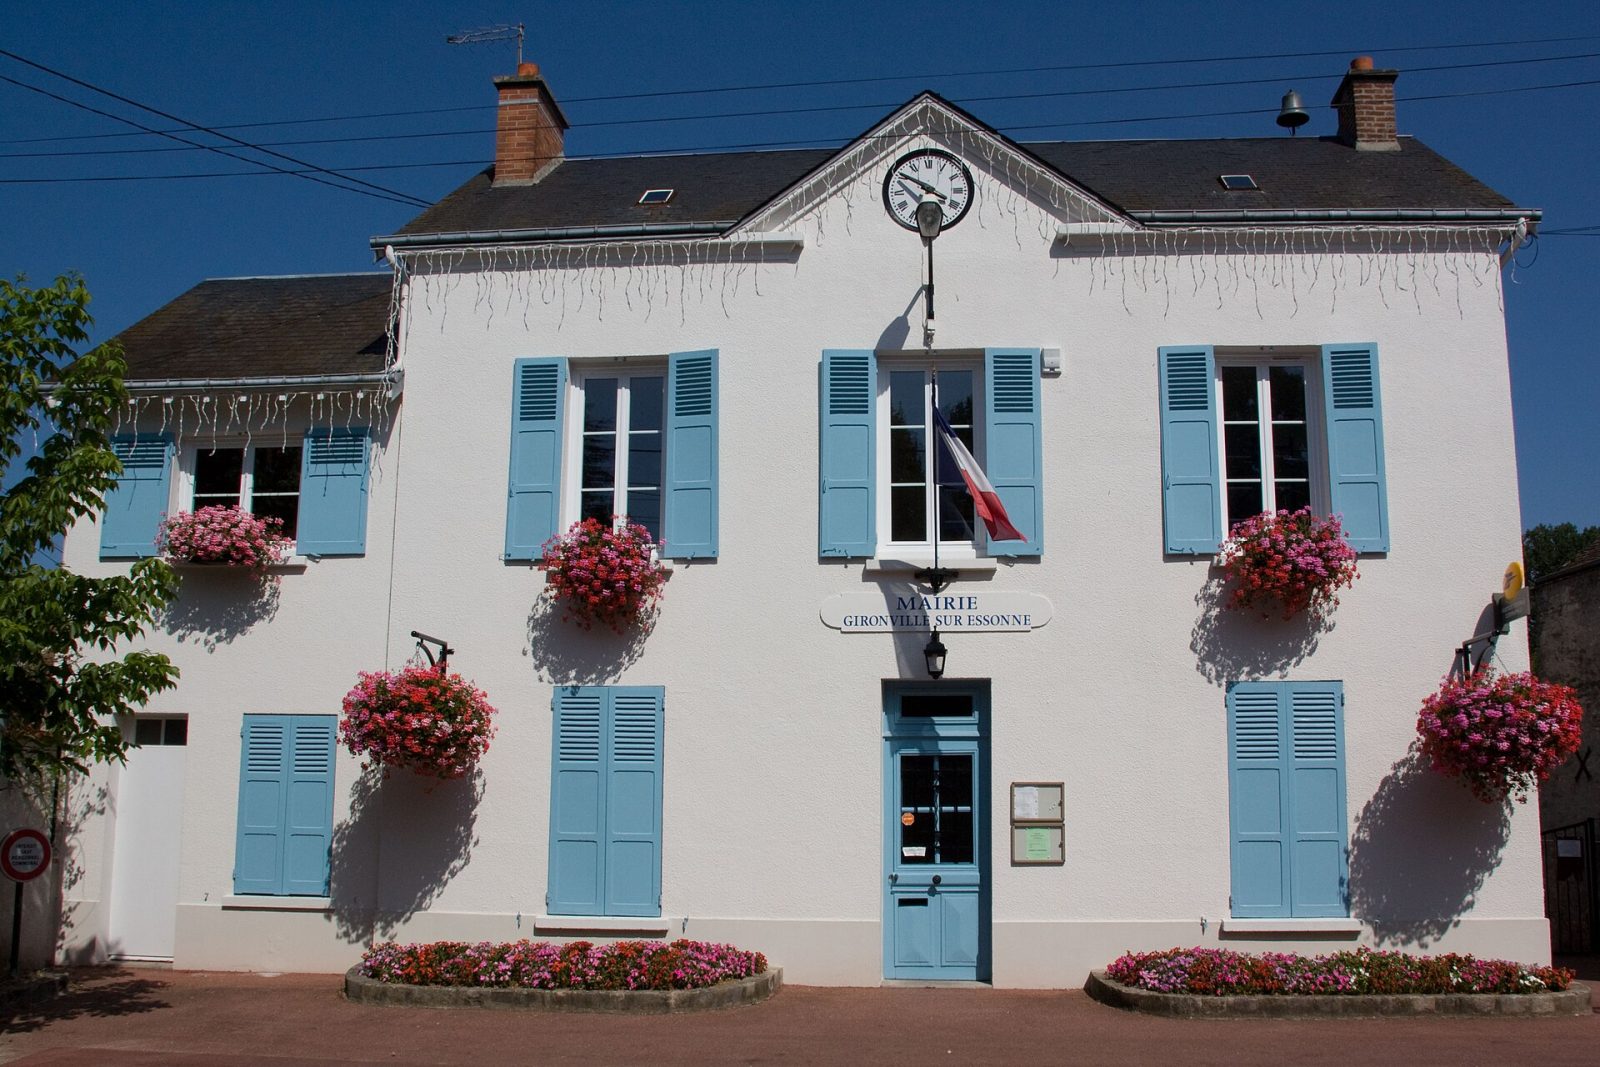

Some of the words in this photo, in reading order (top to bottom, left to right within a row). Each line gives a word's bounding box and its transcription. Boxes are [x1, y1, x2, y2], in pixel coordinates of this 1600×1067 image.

[897, 596, 978, 610] MAIRIE
[843, 615, 930, 627] GIRONVILLE
[935, 615, 963, 627] SUR
[967, 614, 1031, 626] ESSONNE
